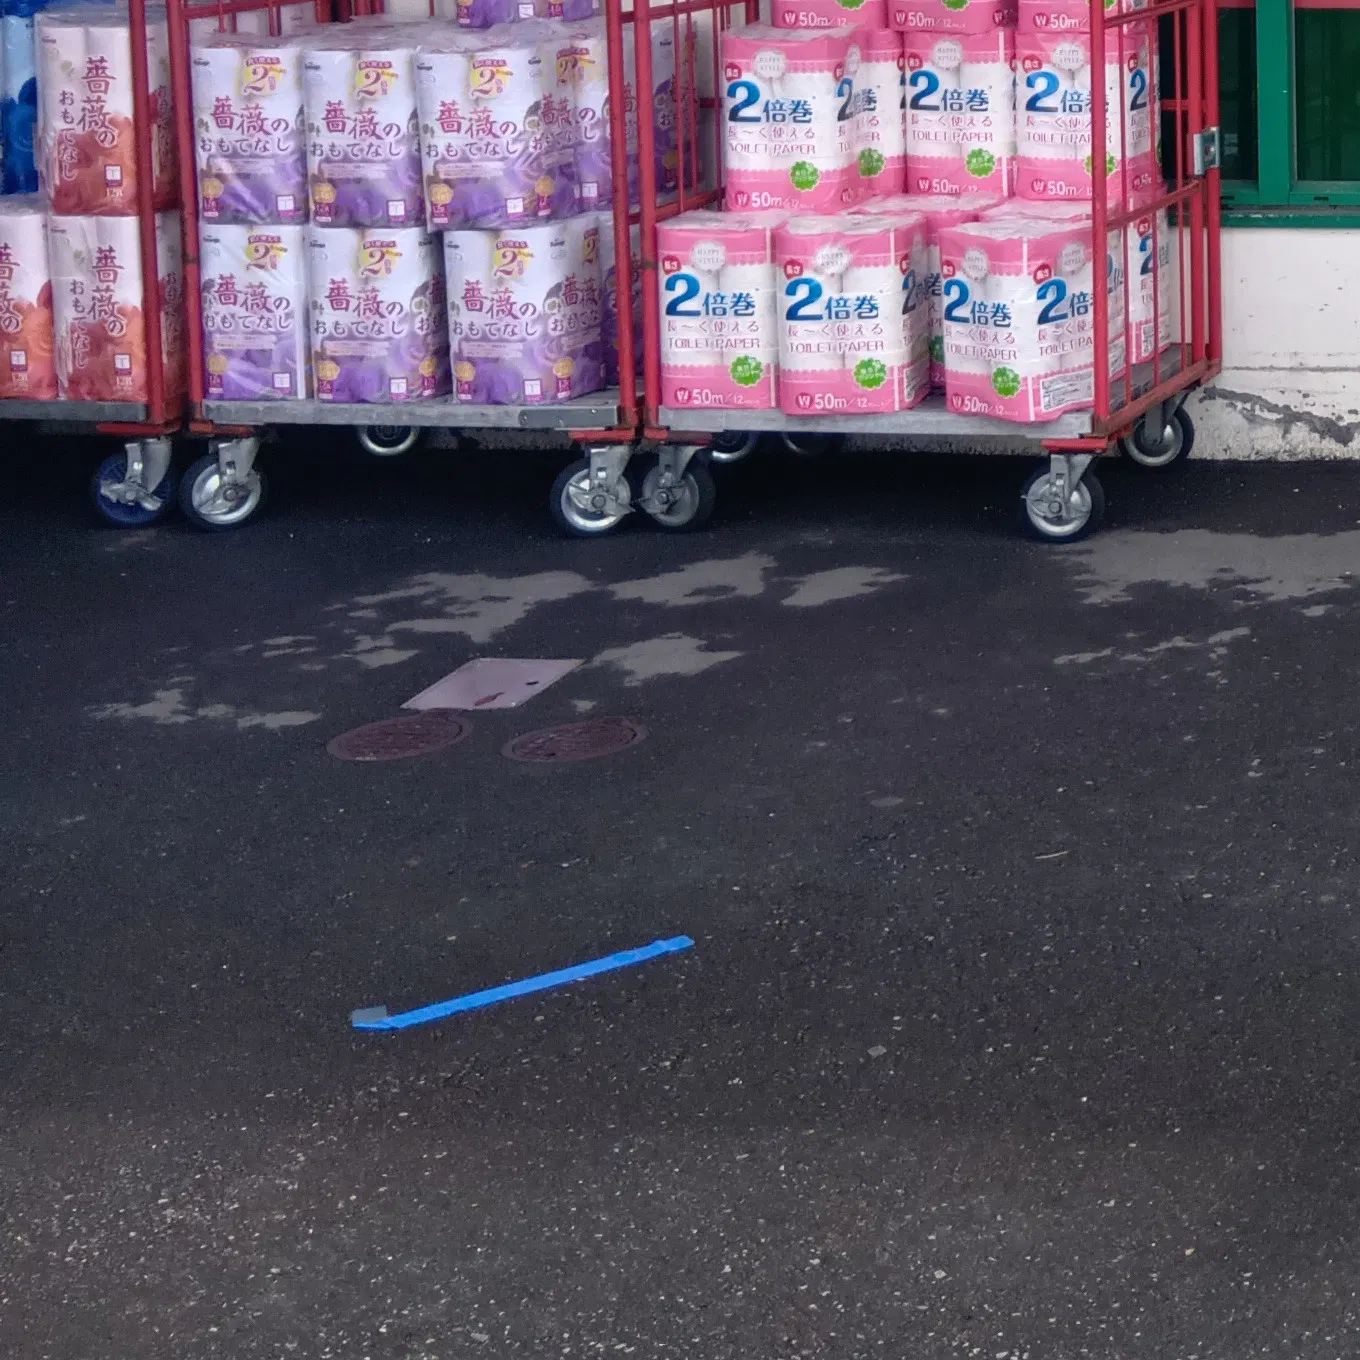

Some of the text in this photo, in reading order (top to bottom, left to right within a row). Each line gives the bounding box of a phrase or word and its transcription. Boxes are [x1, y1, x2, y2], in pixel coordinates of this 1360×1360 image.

[1035, 14, 1048, 26] W
[77, 56, 116, 145] 薔薇の
[727, 80, 812, 123] 2倍巻
[909, 70, 989, 112] 2倍巻
[59, 90, 77, 179] おもてなし
[211, 95, 289, 135] 薔薇の
[322, 99, 400, 140] 薔薇の
[436, 100, 517, 138] 薔薇の
[200, 138, 290, 153] おもてなし
[310, 141, 402, 157] おもてなし
[426, 141, 519, 157] おもてなし
[773, 144, 816, 154] PAPER
[912, 130, 993, 142] TOILET PAPER
[88, 245, 124, 334] 薔薇の
[215, 273, 291, 313] 薔薇の
[325, 278, 404, 318] 薔薇の
[461, 279, 537, 320] 薔薇の
[665, 273, 756, 317] 2倍巻
[786, 277, 879, 321] 2倍巻
[944, 279, 1011, 327] 2倍巻
[1036, 279, 1094, 325] 2倍
[70, 279, 89, 368] おもてなし
[204, 314, 292, 329] おもてなし
[314, 319, 404, 335] おもてなし
[452, 321, 539, 337] おもてなし
[668, 337, 760, 349] TOILET PAPER
[789, 341, 884, 353] TOILET PAPER
[980, 346, 1017, 360] PAPER
[798, 395, 811, 407] W
